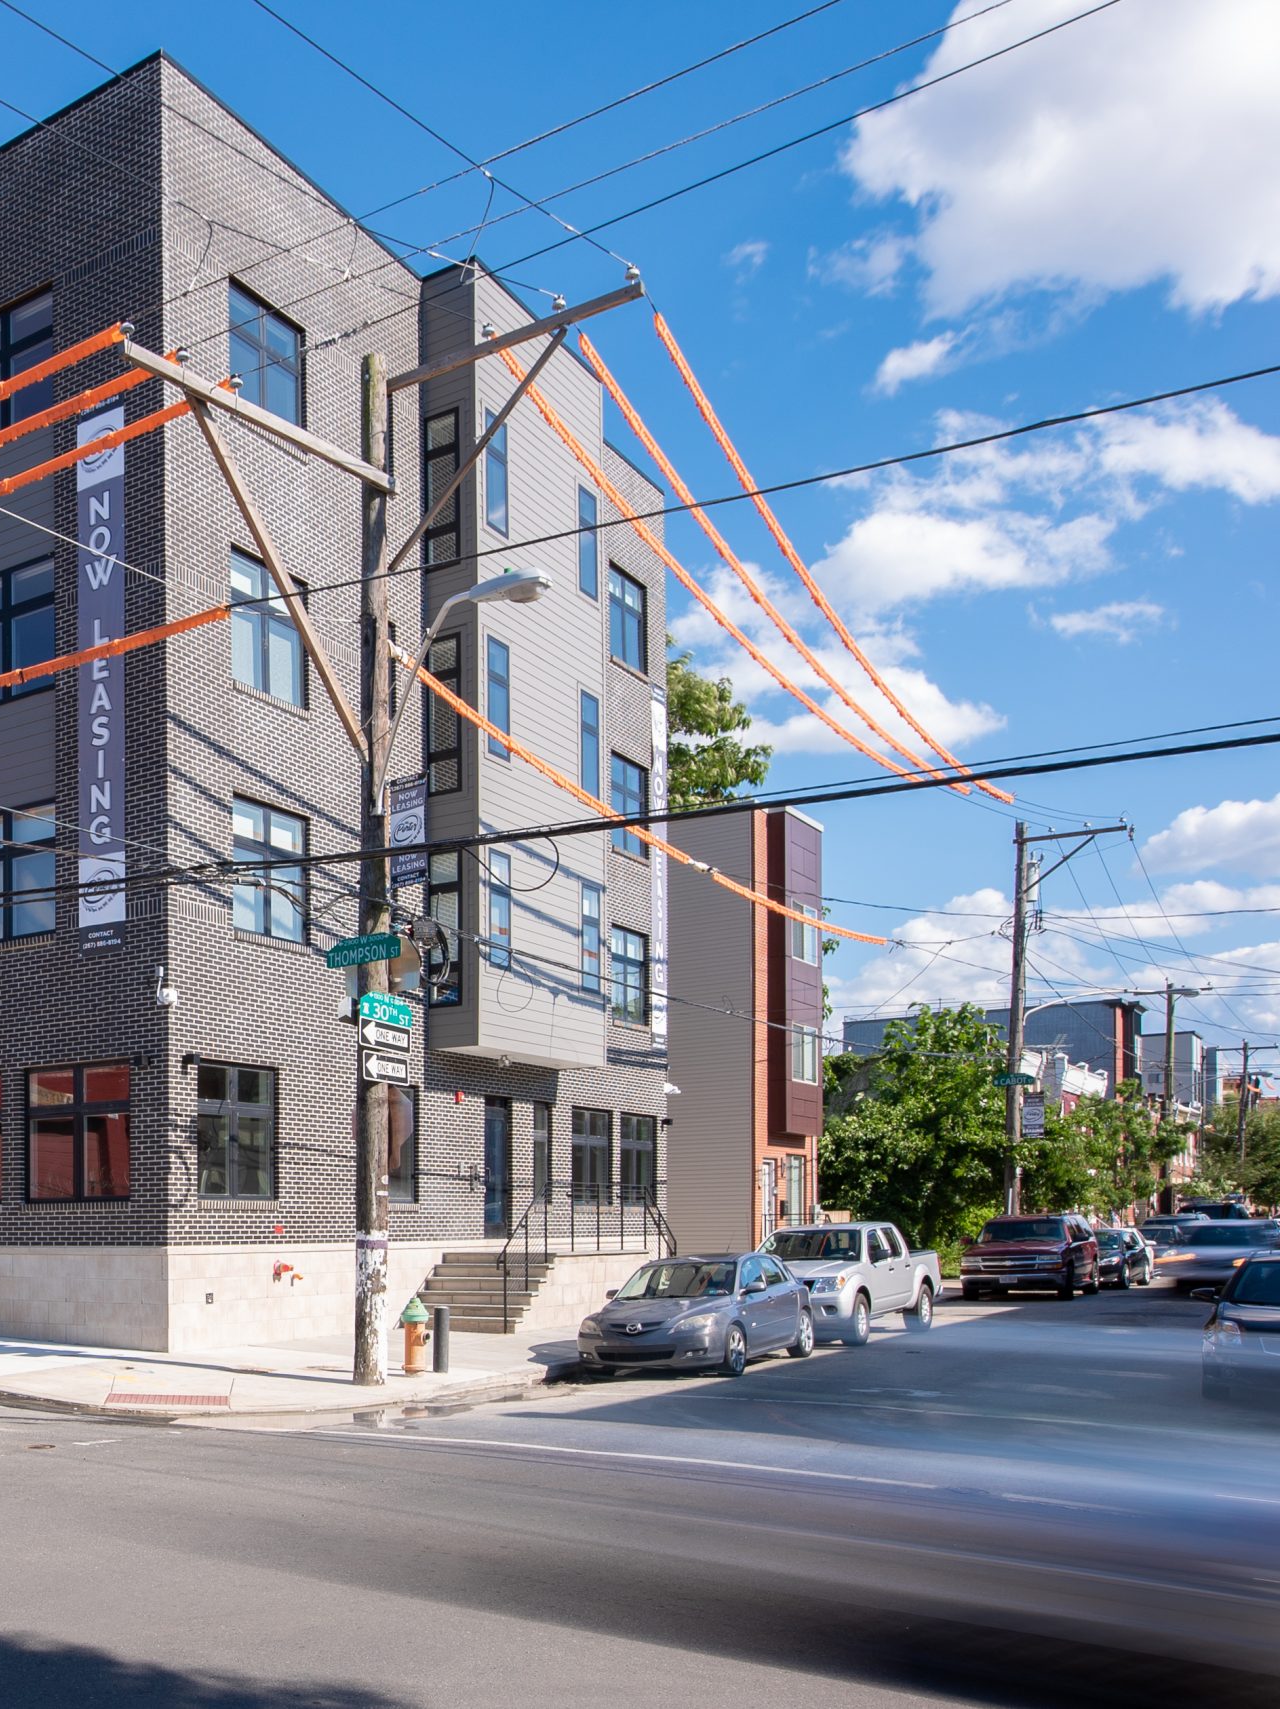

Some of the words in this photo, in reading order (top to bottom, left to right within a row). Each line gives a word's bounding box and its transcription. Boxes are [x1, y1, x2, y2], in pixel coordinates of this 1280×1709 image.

[85, 490, 117, 590] NOW
[89, 618, 112, 845] LEASING
[396, 774, 419, 785] CONTACT
[654, 754, 665, 816] NOW
[399, 790, 418, 801] NOW
[391, 797, 424, 812] LEASING
[399, 853, 417, 862] NOW
[392, 860, 425, 874] LEASING
[397, 872, 420, 882] CONTACT
[88, 930, 114, 939] CONTACT
[360, 935, 368, 945] W
[83, 942, 97, 950] (267)
[328, 943, 387, 968] THOMPSON
[390, 946, 399, 957] ST
[373, 1002, 398, 1021] 30TH
[399, 1014, 410, 1026] ST
[376, 1029, 389, 1042] ONE
[392, 1033, 405, 1046] WAY
[377, 1062, 389, 1074] ONE
[391, 1064, 404, 1076] WAY
[1000, 1077, 1027, 1085] CABOT
